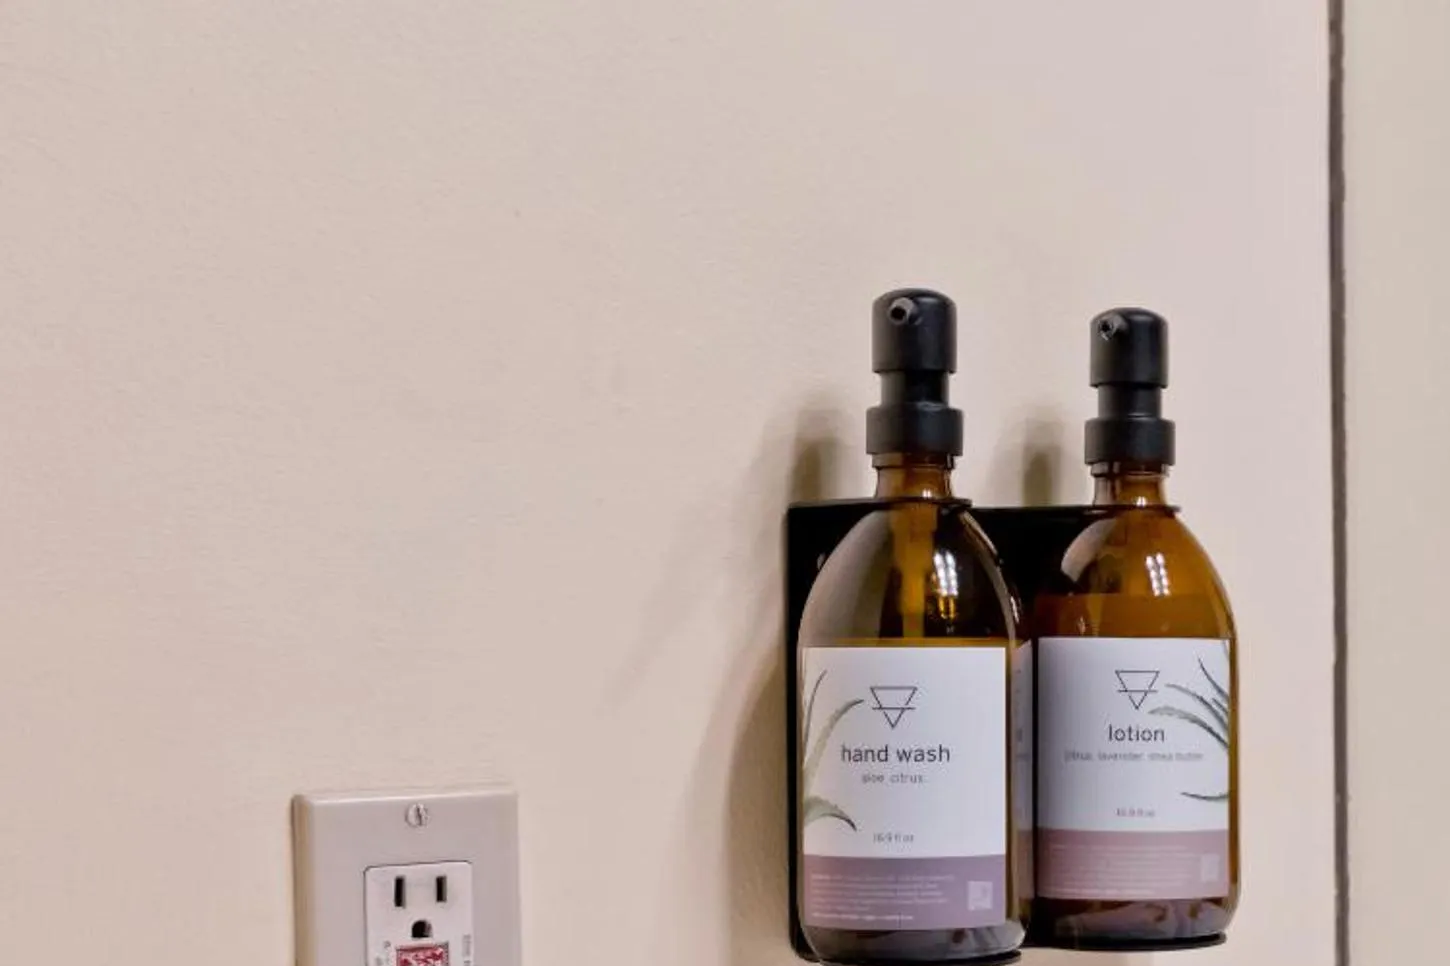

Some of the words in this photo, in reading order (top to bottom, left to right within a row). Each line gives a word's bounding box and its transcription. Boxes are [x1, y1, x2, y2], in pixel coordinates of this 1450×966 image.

[1107, 723, 1165, 742] lotion
[841, 743, 889, 762] hand
[896, 743, 950, 762] wash
